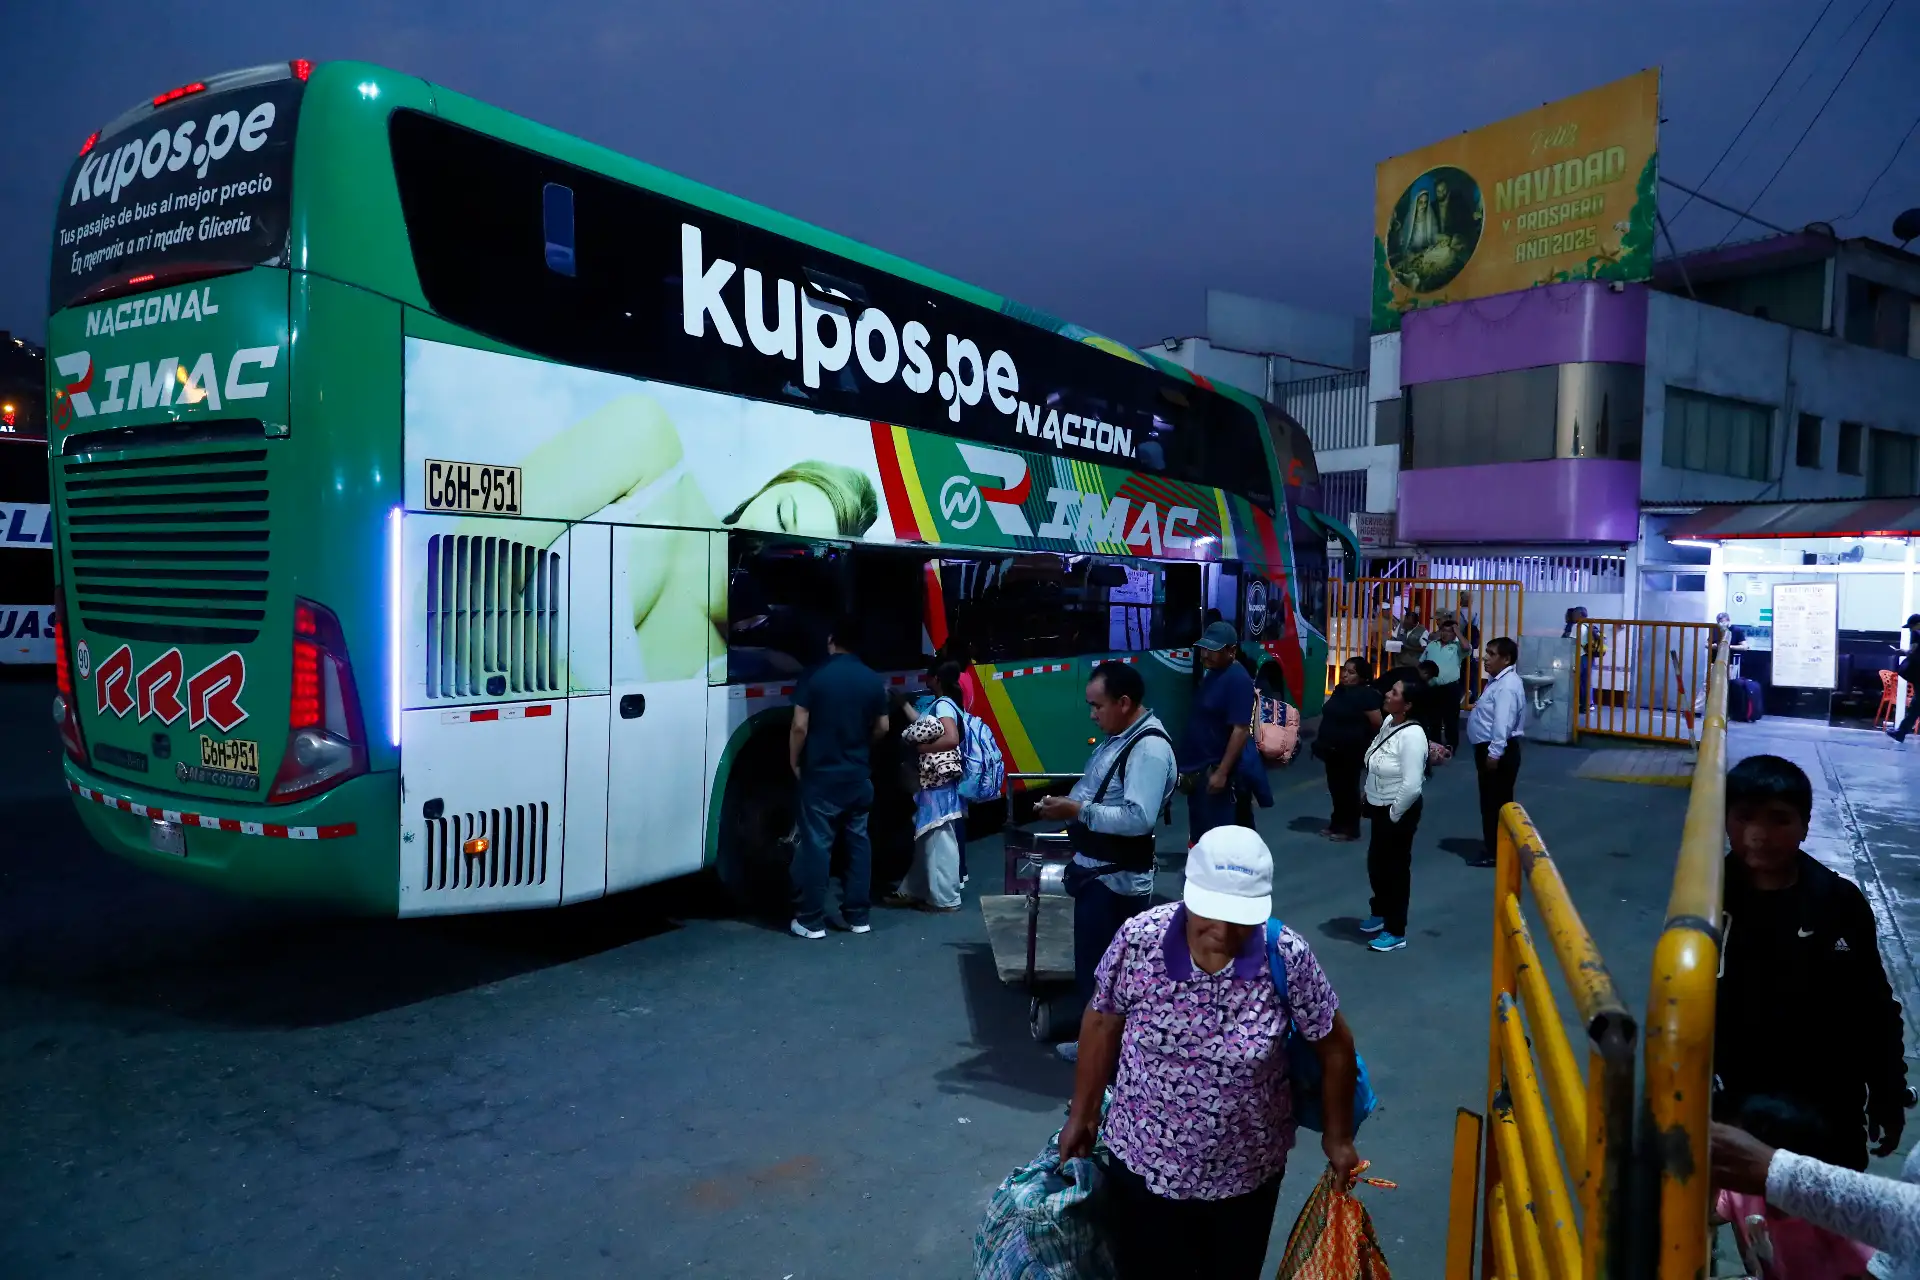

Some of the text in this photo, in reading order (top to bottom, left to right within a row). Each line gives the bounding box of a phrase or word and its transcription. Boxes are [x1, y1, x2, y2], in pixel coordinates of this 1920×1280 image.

[70, 101, 276, 206] kupos.pe
[1495, 145, 1626, 213] NAVIDAD
[60, 172, 273, 247] Tus pasajes de bus al mejor precio
[1552, 225, 1597, 254] 2025
[71, 250, 82, 275] En
[127, 238, 134, 255] a
[154, 220, 194, 252] madre
[198, 211, 251, 241] Gliceria
[85, 286, 219, 338] NACIONAL
[681, 223, 1019, 422] kupos.pe
[54, 345, 280, 418] RIMAC
[1016, 400, 1136, 458] NACION
[430, 463, 518, 512] C6H-951
[955, 443, 1199, 555] RIMAC
[79, 649, 88, 669] 90
[202, 737, 257, 772] C6H-951
